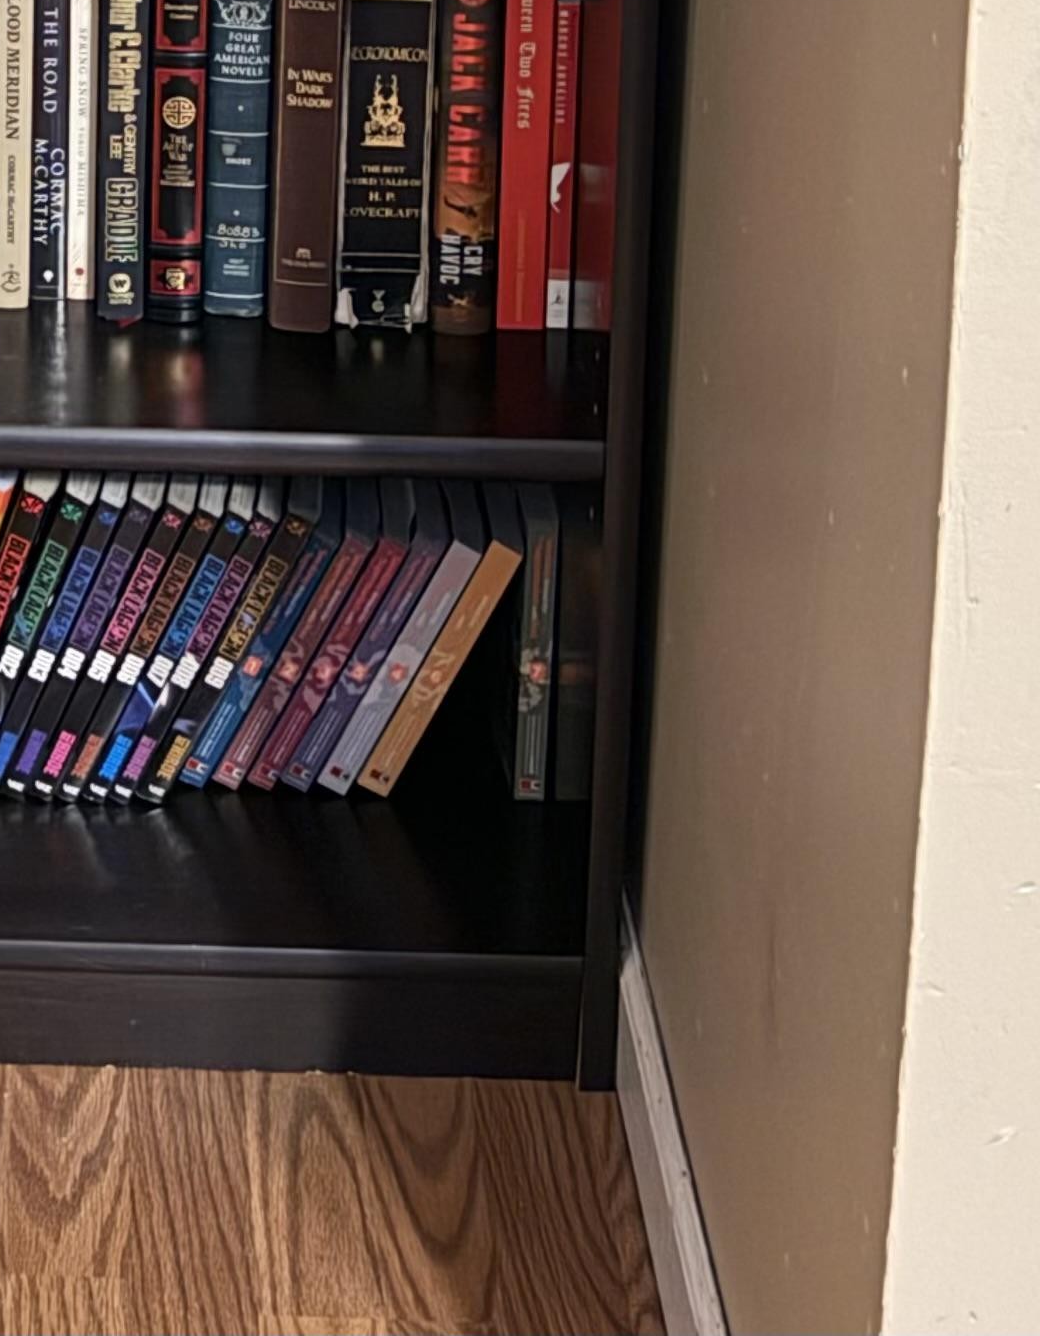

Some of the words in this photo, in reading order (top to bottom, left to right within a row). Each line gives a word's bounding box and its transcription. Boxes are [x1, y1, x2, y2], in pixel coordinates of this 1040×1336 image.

[288, 0, 336, 11] LINCOLN
[214, 54, 270, 64] AMERICAN
[221, 65, 263, 76] NOVELS
[6, 47, 20, 140] MERIDIAN
[44, 57, 58, 114] ROAD
[286, 96, 333, 108] SHADOW
[440, 234, 460, 286] HAVOC
[463, 246, 483, 276] CRY
